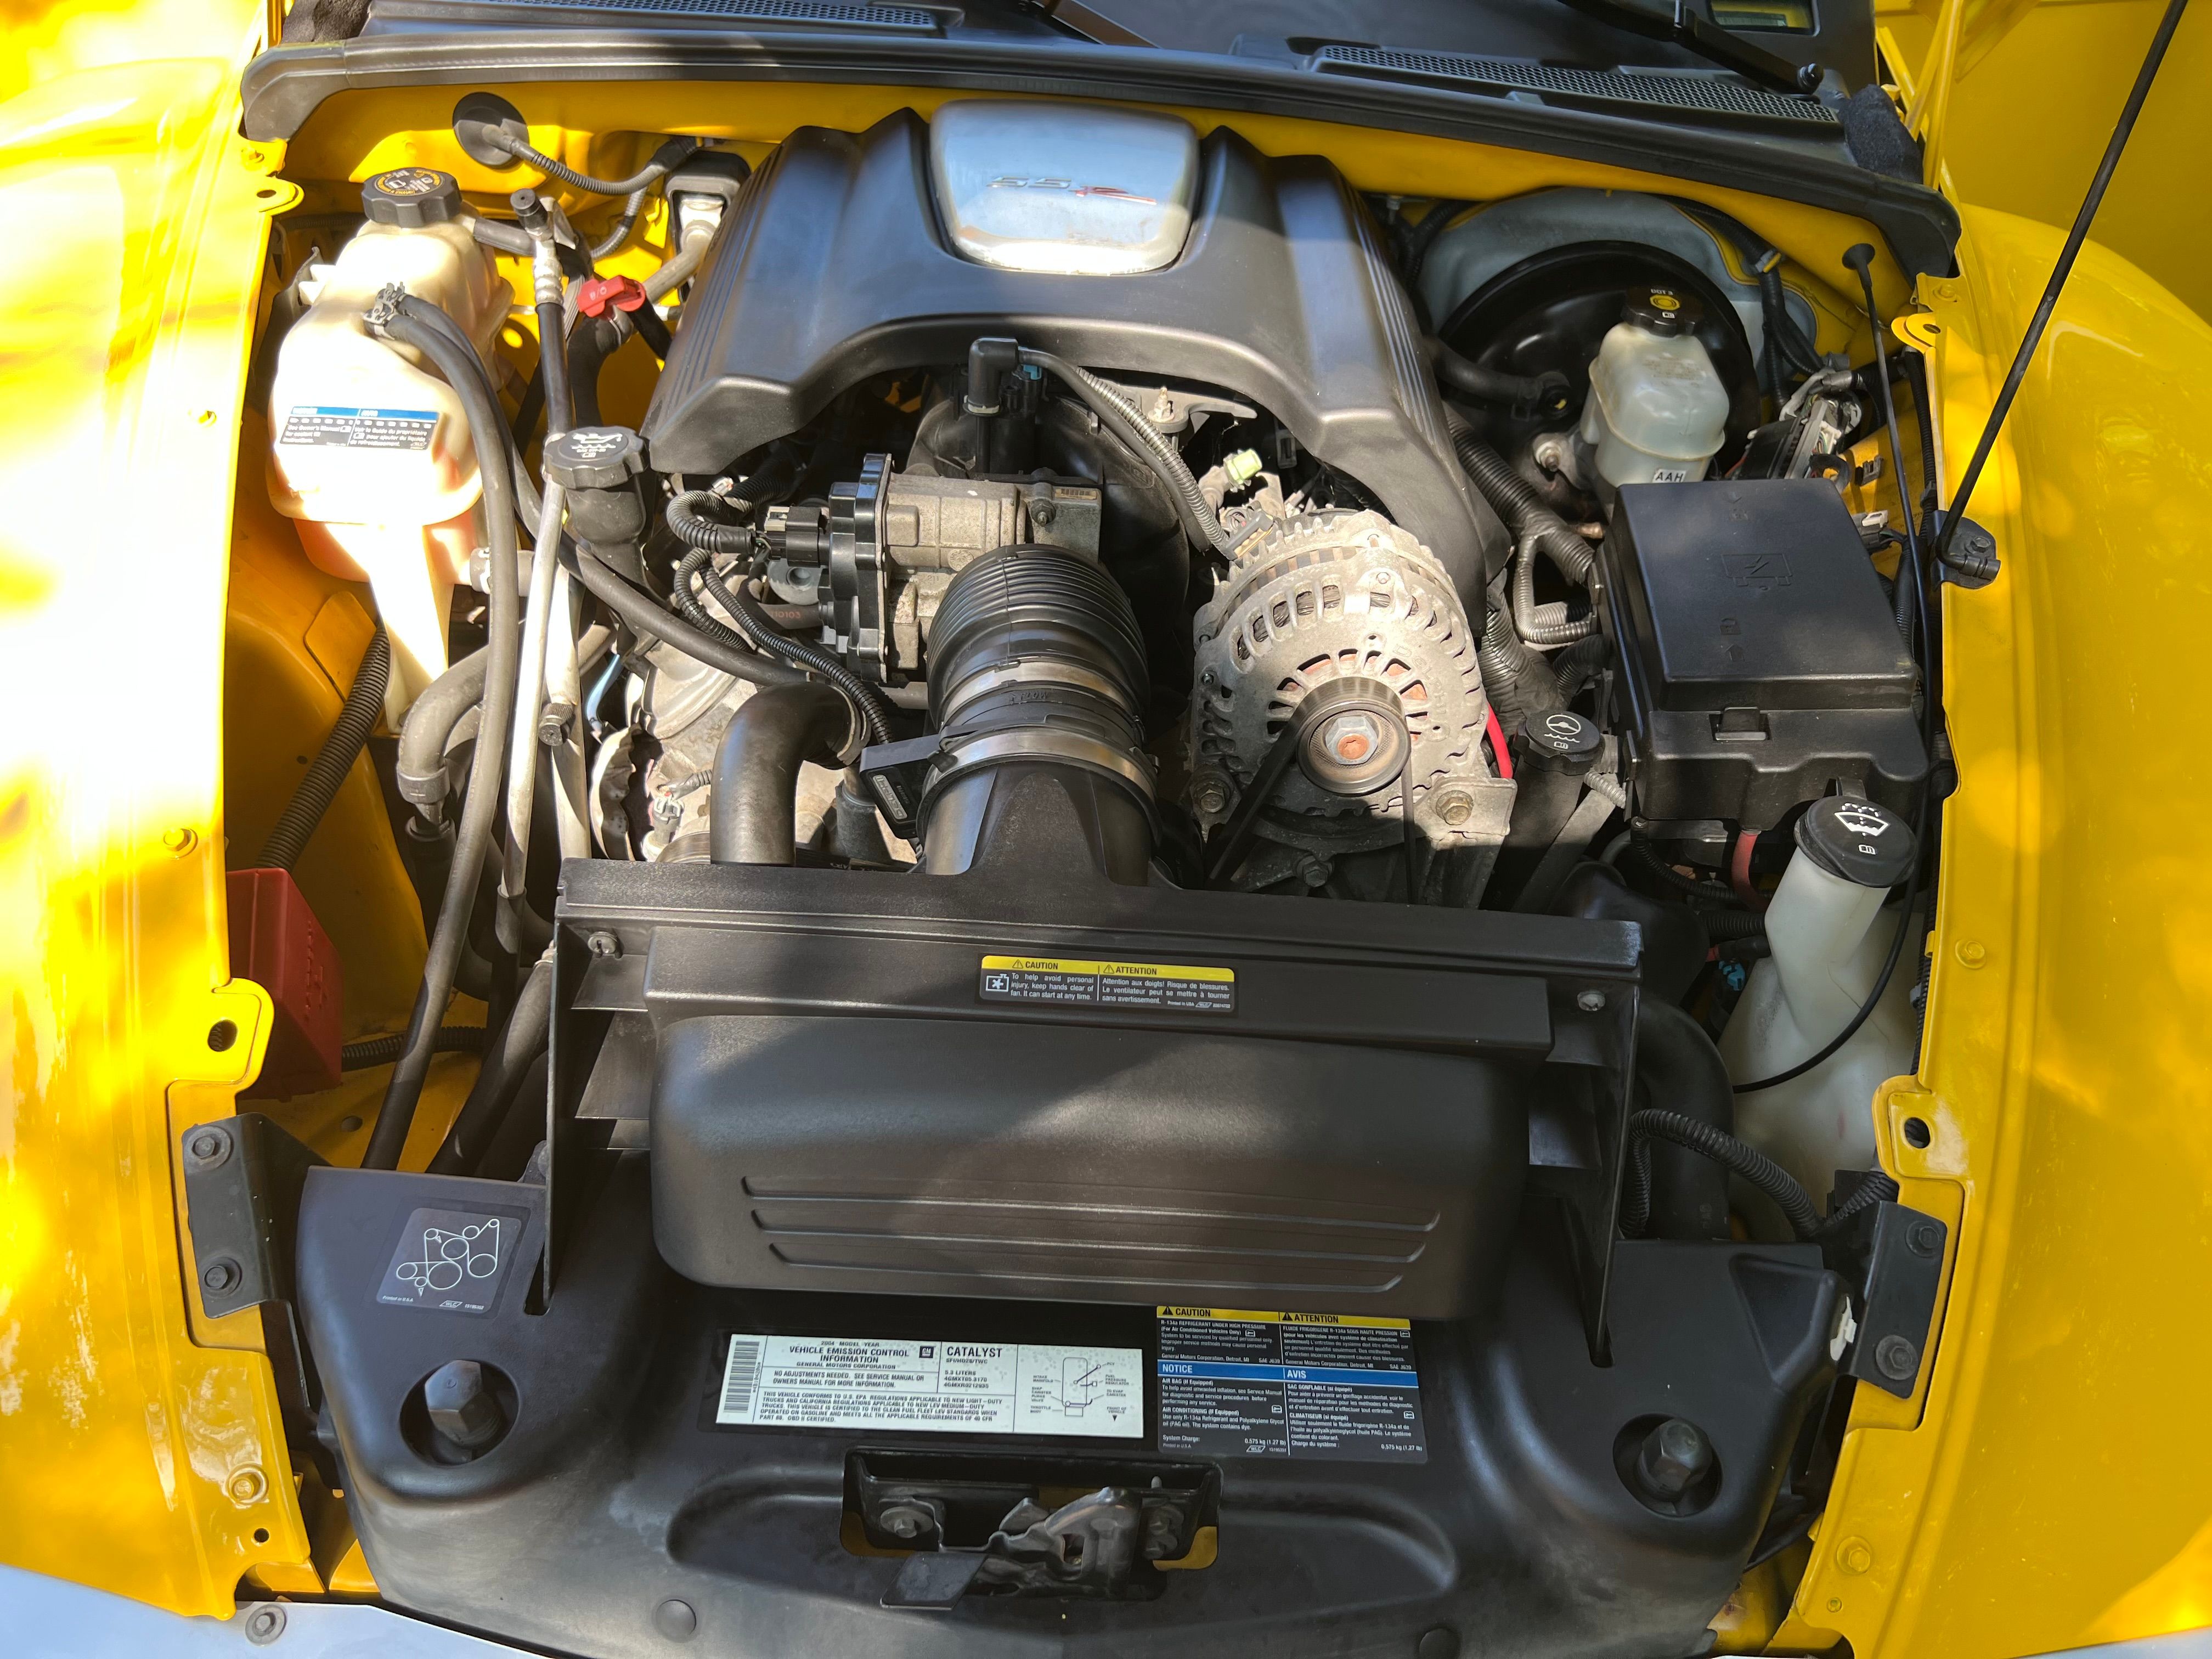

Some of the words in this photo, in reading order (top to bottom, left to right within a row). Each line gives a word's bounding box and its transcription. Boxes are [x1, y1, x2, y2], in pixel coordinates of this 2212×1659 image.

[1656, 471, 1684, 483] AAH
[1025, 961, 1058, 969] CAUTION
[1116, 966, 1156, 975] ATTENTION
[1024, 973, 1039, 981] help
[1044, 974, 1061, 982] avoid
[1067, 975, 1094, 984] personal
[1031, 981, 1046, 990] keep
[1049, 983, 1067, 991] hands
[1069, 984, 1085, 992] clear
[1087, 984, 1094, 992] of
[1102, 978, 1129, 986] Attention
[1199, 983, 1229, 991] blessures.
[1041, 991, 1056, 999] start
[1113, 986, 1146, 995] ventilateur
[1117, 996, 1161, 1004] avertissement.
[1175, 1307, 1211, 1317] CAUTION
[1294, 1313, 1339, 1323] ATTENTION
[788, 1345, 824, 1354] VEHICLE
[826, 1347, 867, 1355] EMISSION
[870, 1348, 910, 1357] CONTROL
[946, 1345, 1002, 1358] CATALYST
[820, 1354, 879, 1363] INFORMATION
[1162, 1363, 1193, 1373] NOTICE
[1286, 1369, 1307, 1379] AVIS
[1172, 1407, 1207, 1415] CONDITIONING
